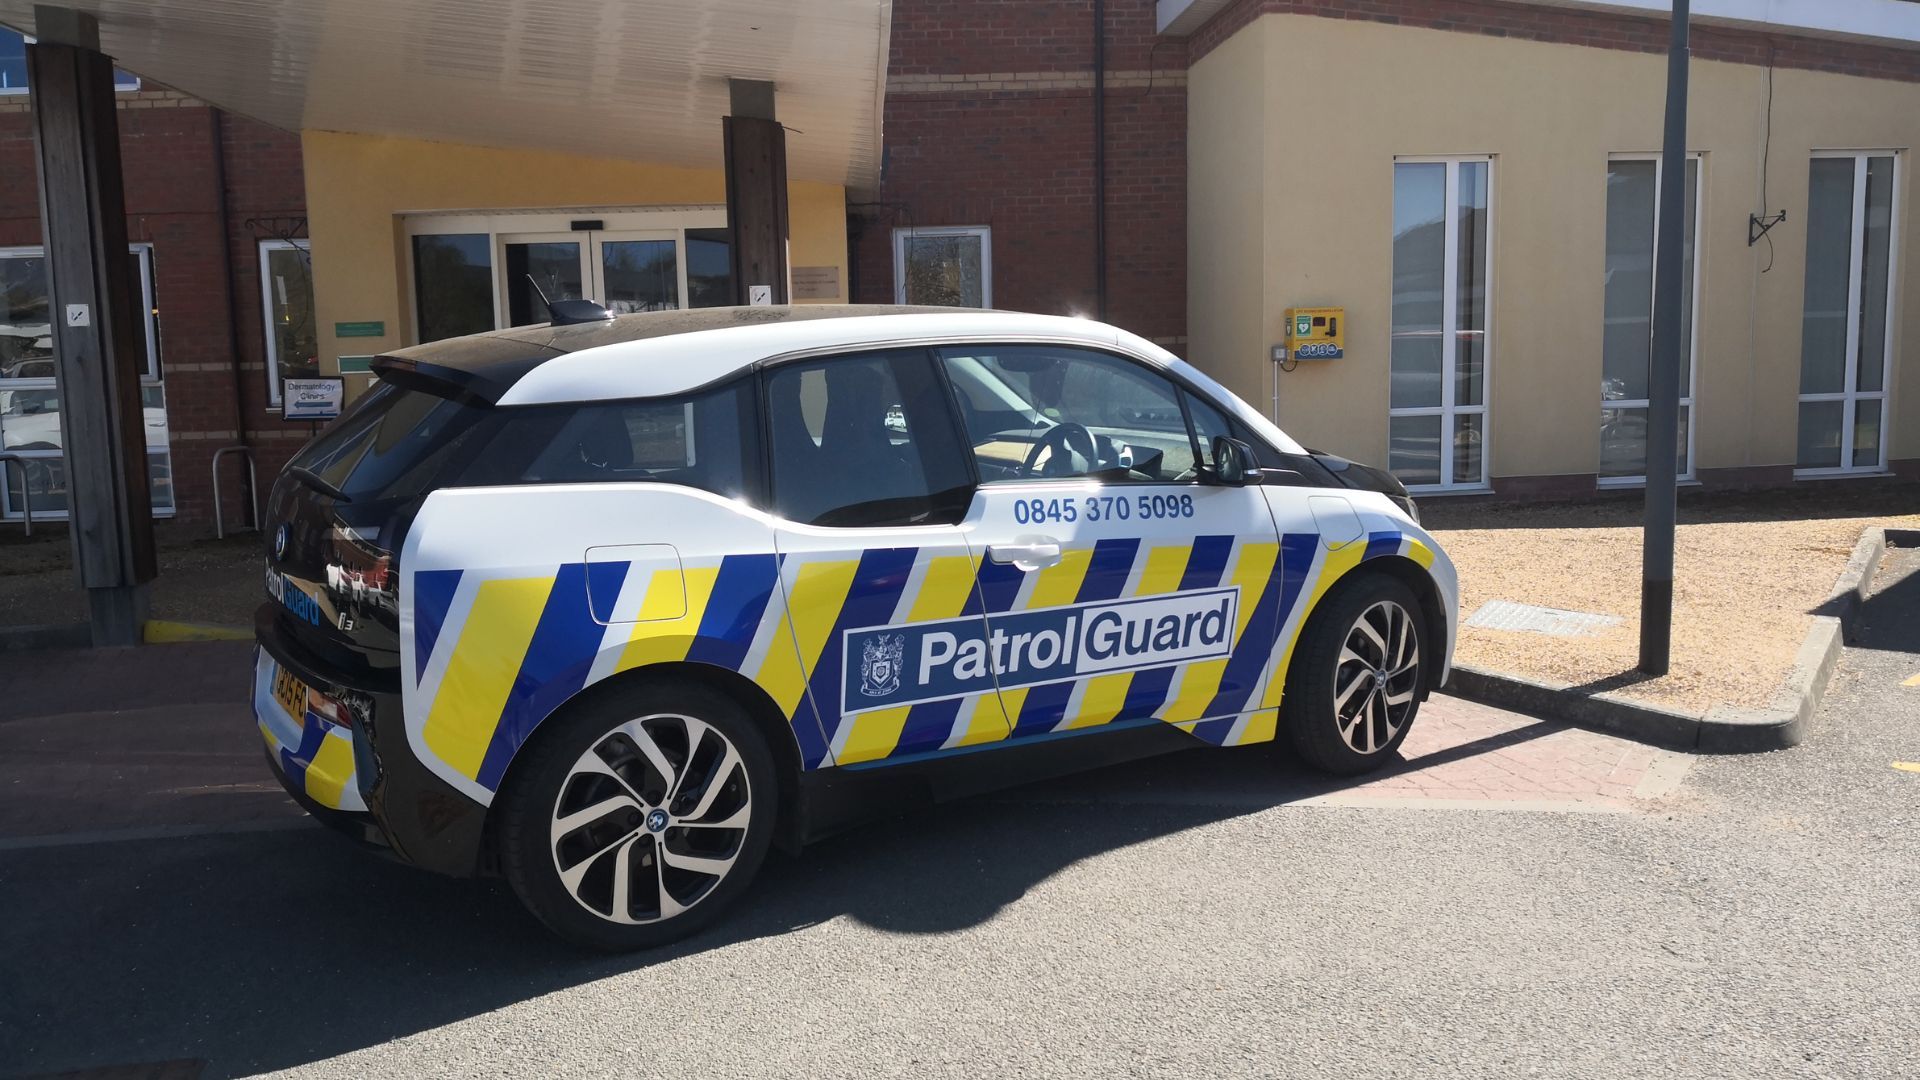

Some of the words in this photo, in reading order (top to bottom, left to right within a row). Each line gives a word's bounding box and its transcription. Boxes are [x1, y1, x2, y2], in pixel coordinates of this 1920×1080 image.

[288, 382, 336, 391] Dermatology
[1014, 498, 1077, 525] 0845
[1085, 496, 1130, 522] 370
[1138, 494, 1194, 520] 5098
[337, 611, 354, 631] i3
